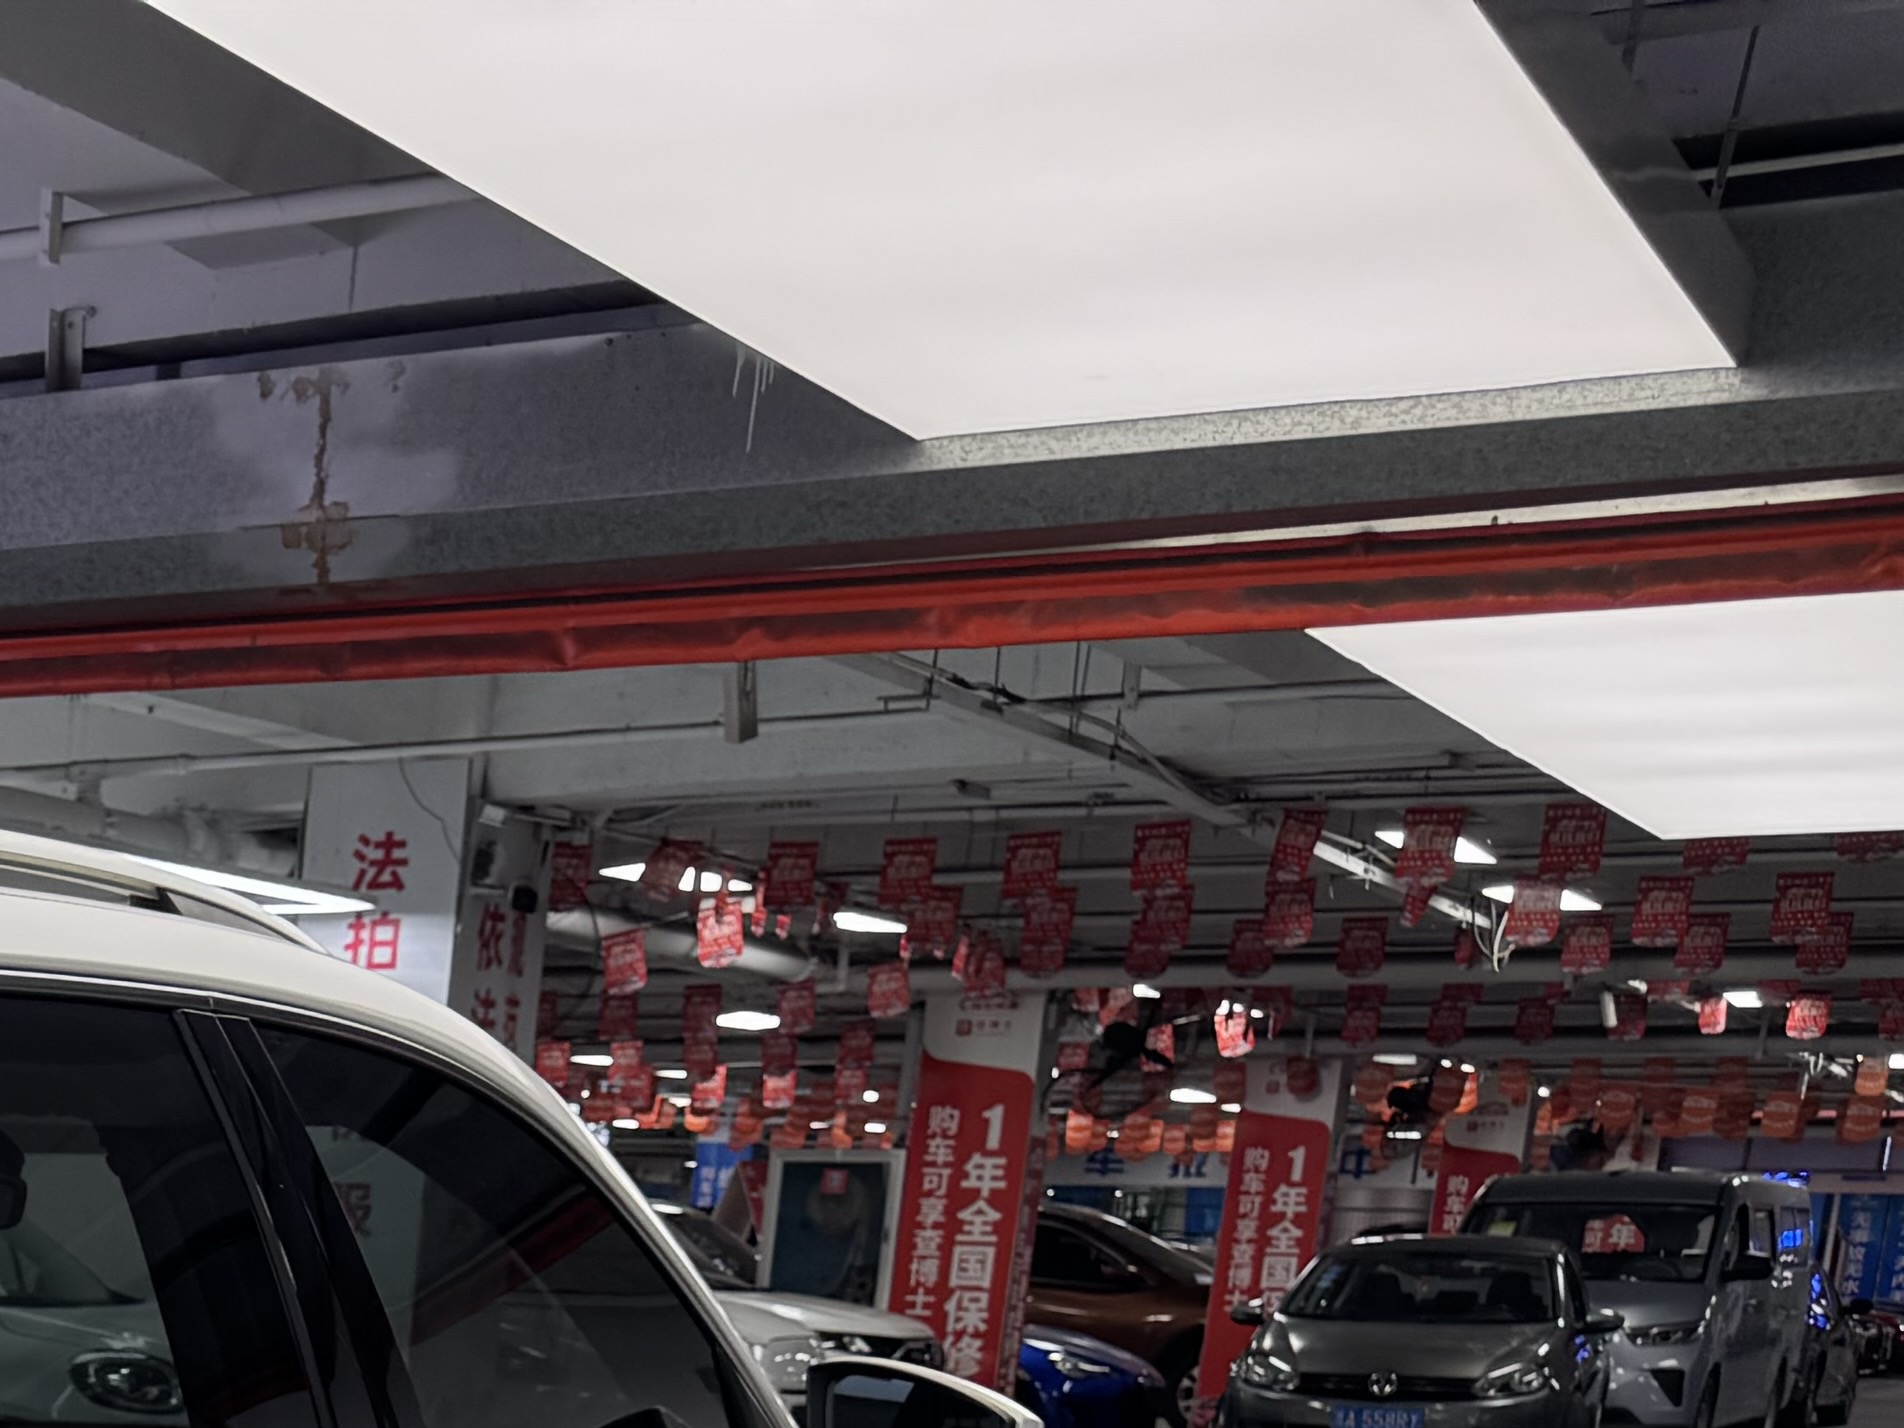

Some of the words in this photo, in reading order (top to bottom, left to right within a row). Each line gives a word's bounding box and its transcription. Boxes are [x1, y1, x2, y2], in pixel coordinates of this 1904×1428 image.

[905, 1105, 961, 1318] 购车可享查博士
[942, 1103, 1008, 1378] 1年全国保修
